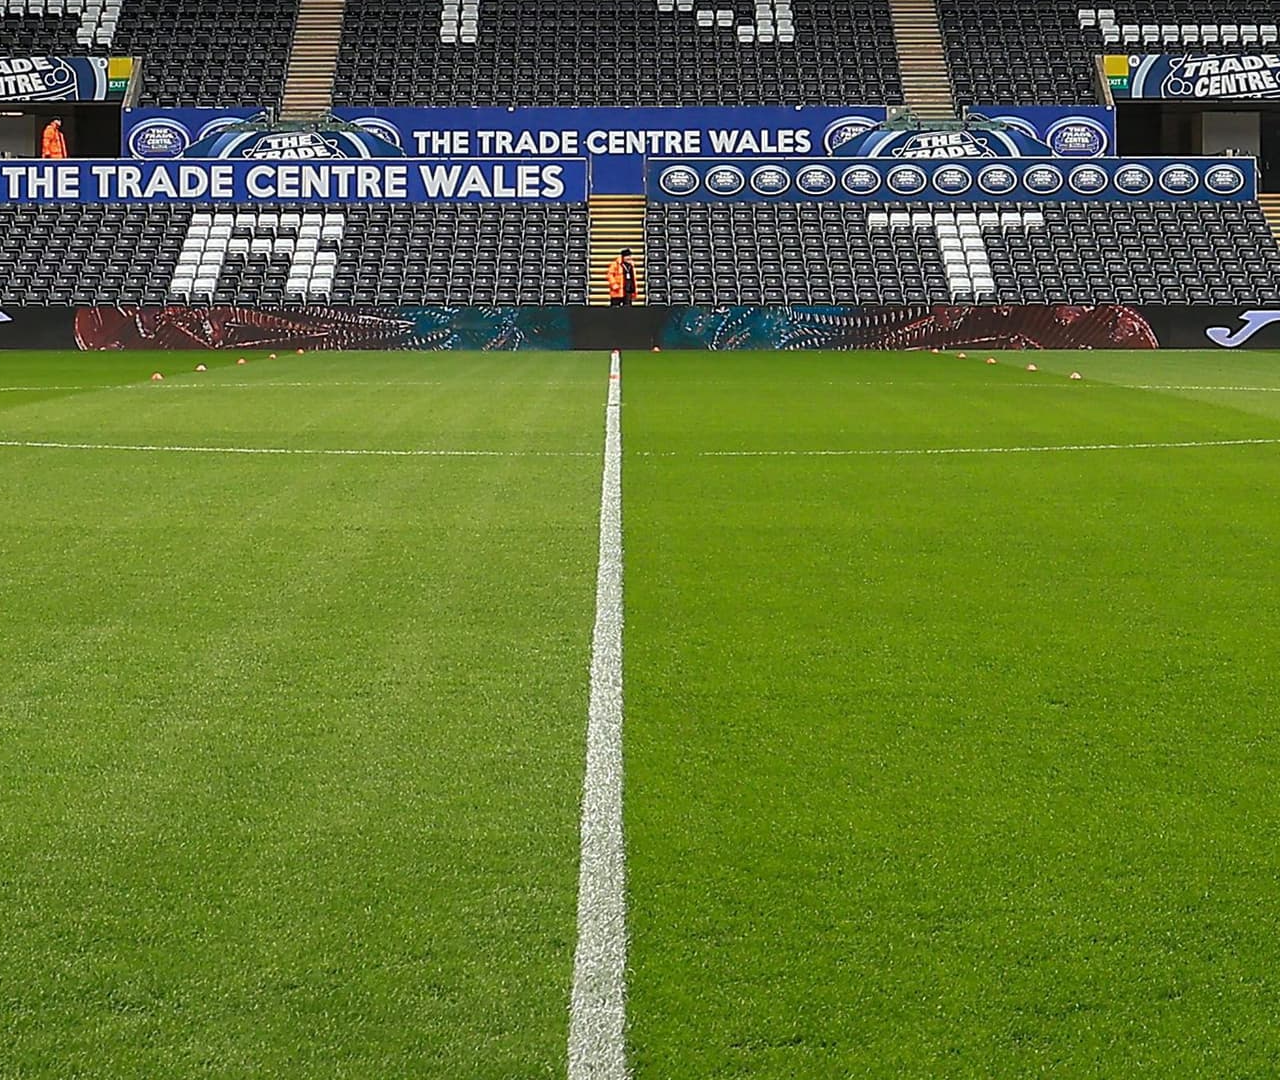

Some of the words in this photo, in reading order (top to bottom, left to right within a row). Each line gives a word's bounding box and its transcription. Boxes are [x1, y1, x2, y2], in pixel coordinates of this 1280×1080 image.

[109, 80, 125, 88] EXIT
[1195, 70, 1279, 97] CENTRE
[267, 135, 312, 149] THE
[414, 131, 468, 154] THE
[478, 131, 577, 154] TRADE
[584, 130, 700, 154] CENTRE
[709, 130, 810, 153] WALES
[917, 133, 963, 147] THE
[3, 167, 78, 199] THE
[92, 166, 232, 199] TRADE
[247, 166, 406, 199] CENTRE
[420, 166, 563, 198] WALES
